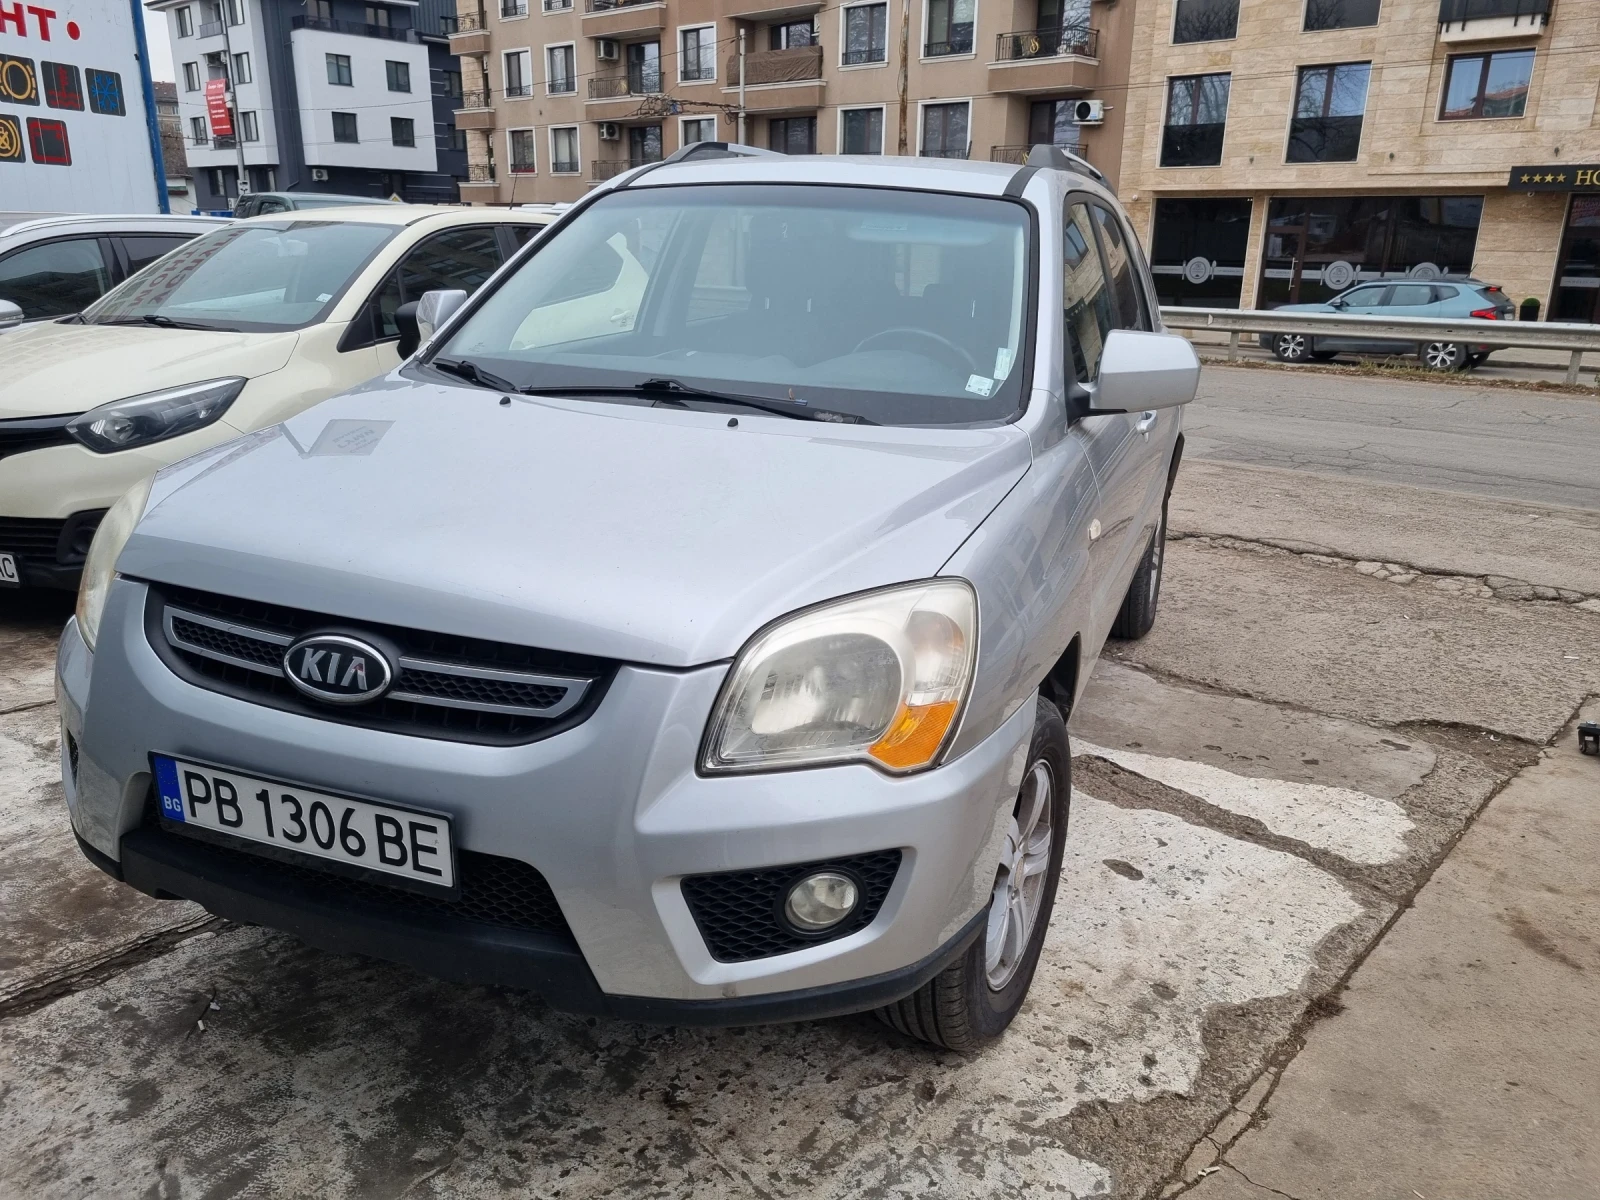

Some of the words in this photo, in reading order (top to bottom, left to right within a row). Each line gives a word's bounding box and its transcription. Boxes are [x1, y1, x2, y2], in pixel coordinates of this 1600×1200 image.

[300, 647, 368, 691] KIA
[163, 795, 182, 813] BG
[184, 770, 243, 828] PB
[256, 789, 367, 857] 1306
[375, 814, 443, 877] BE
